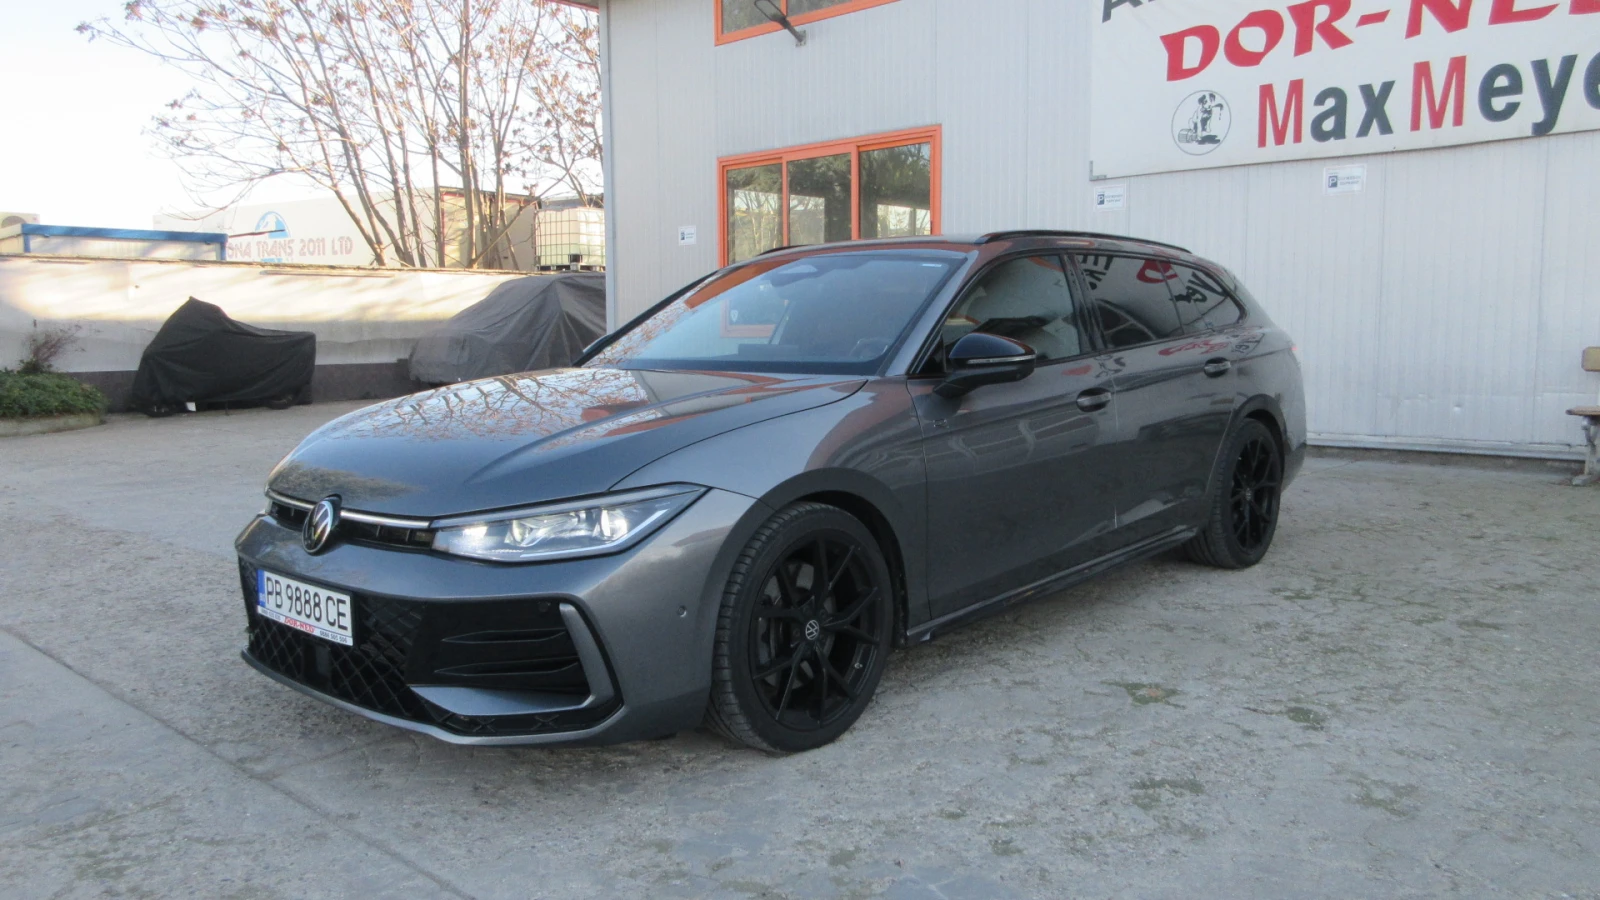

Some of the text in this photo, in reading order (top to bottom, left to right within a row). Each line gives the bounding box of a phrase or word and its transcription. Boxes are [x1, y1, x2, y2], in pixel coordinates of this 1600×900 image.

[1160, 0, 1600, 81] DOR-N
[256, 239, 294, 258] TRANS
[299, 237, 326, 256] 2011
[331, 235, 354, 255] LTD
